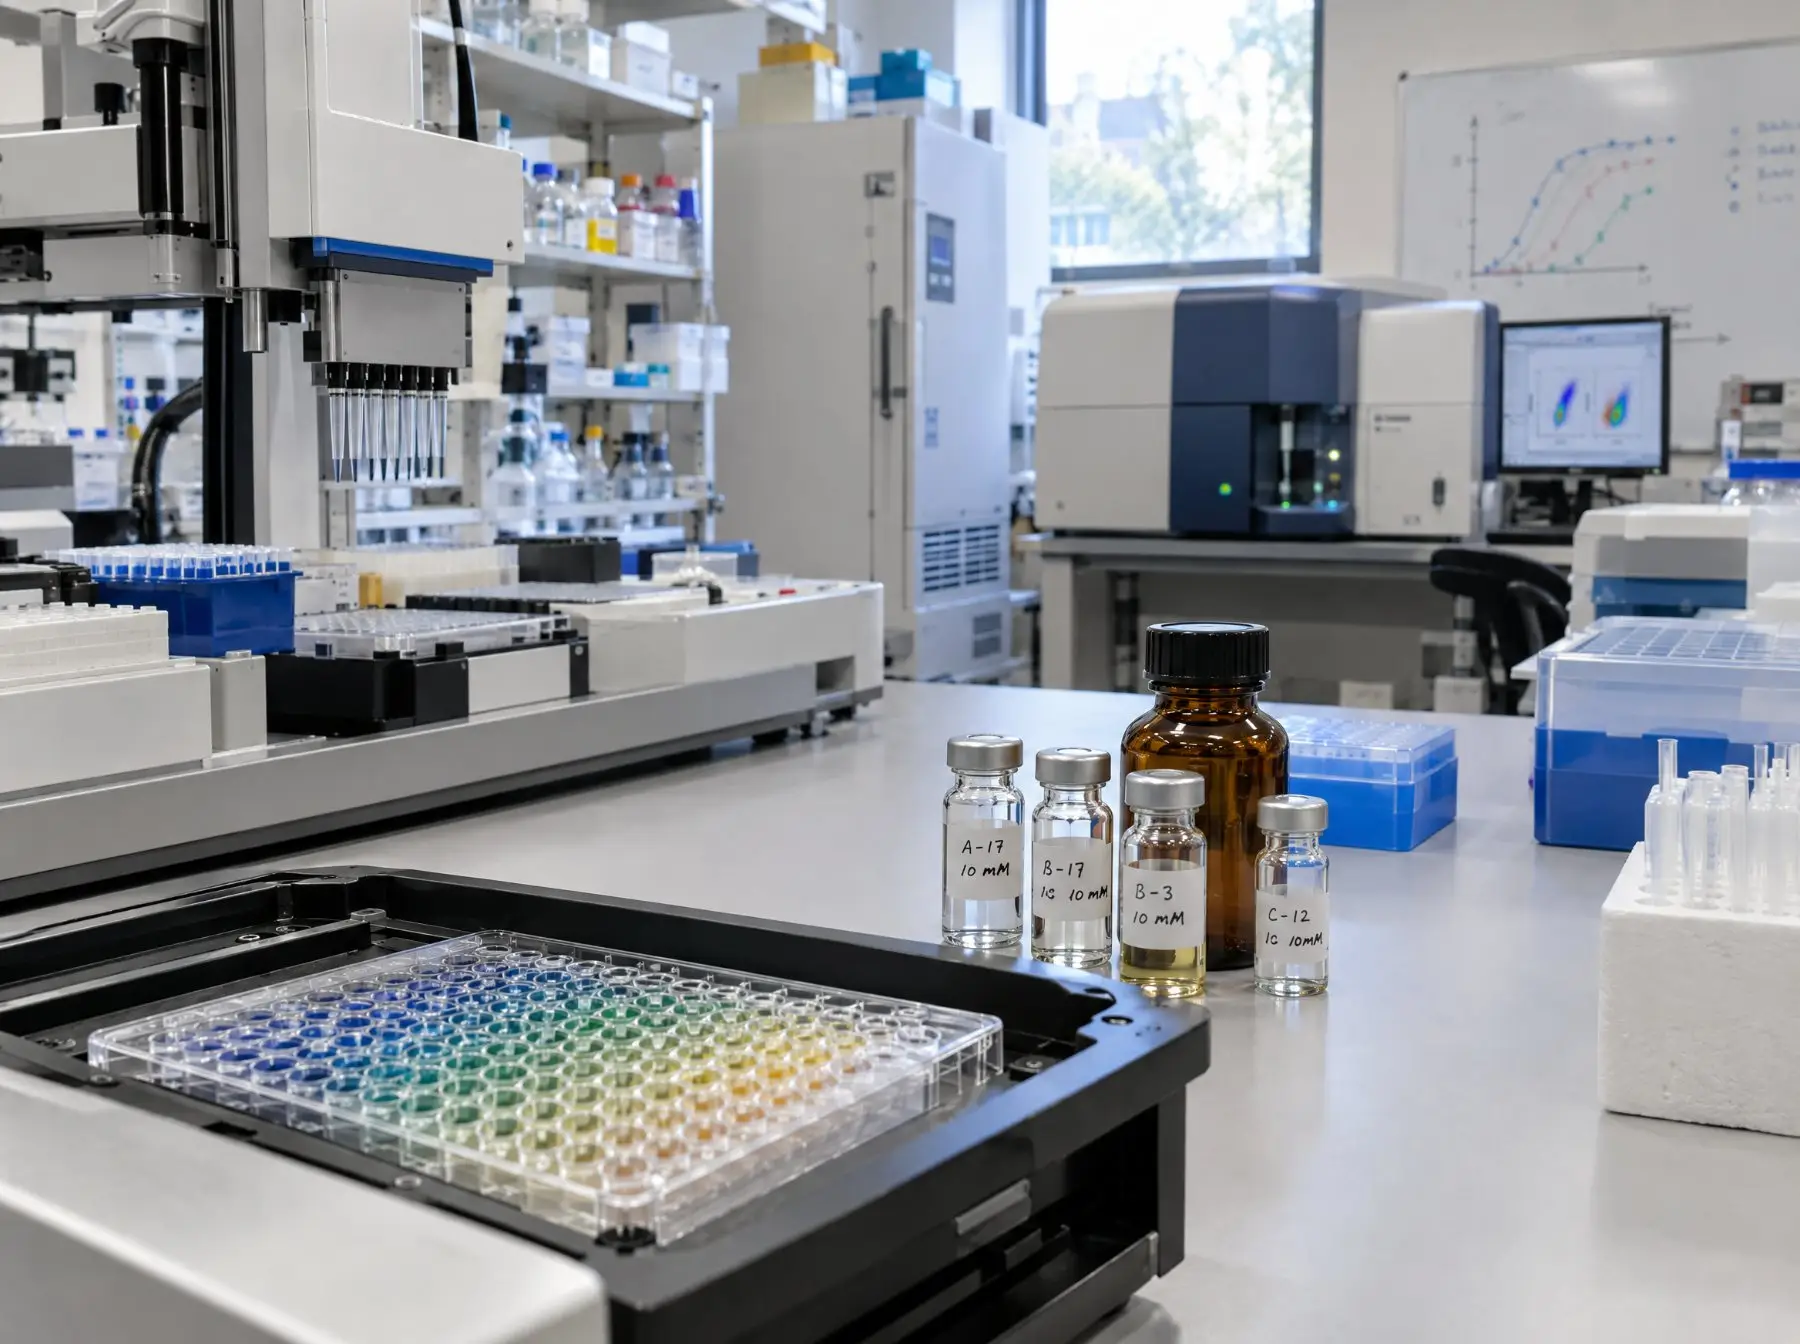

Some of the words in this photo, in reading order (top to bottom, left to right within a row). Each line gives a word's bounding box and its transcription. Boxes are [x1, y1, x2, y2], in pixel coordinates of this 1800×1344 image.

[961, 839, 1004, 854] A-17
[960, 863, 976, 877] 10
[982, 862, 1010, 877] mM
[1043, 859, 1085, 878] B-17
[1069, 888, 1084, 902] 10
[1087, 885, 1109, 900] mM
[1135, 883, 1173, 901] B-3
[1133, 911, 1148, 925] 10
[1154, 911, 1185, 926] mM
[1268, 907, 1310, 923] C-12
